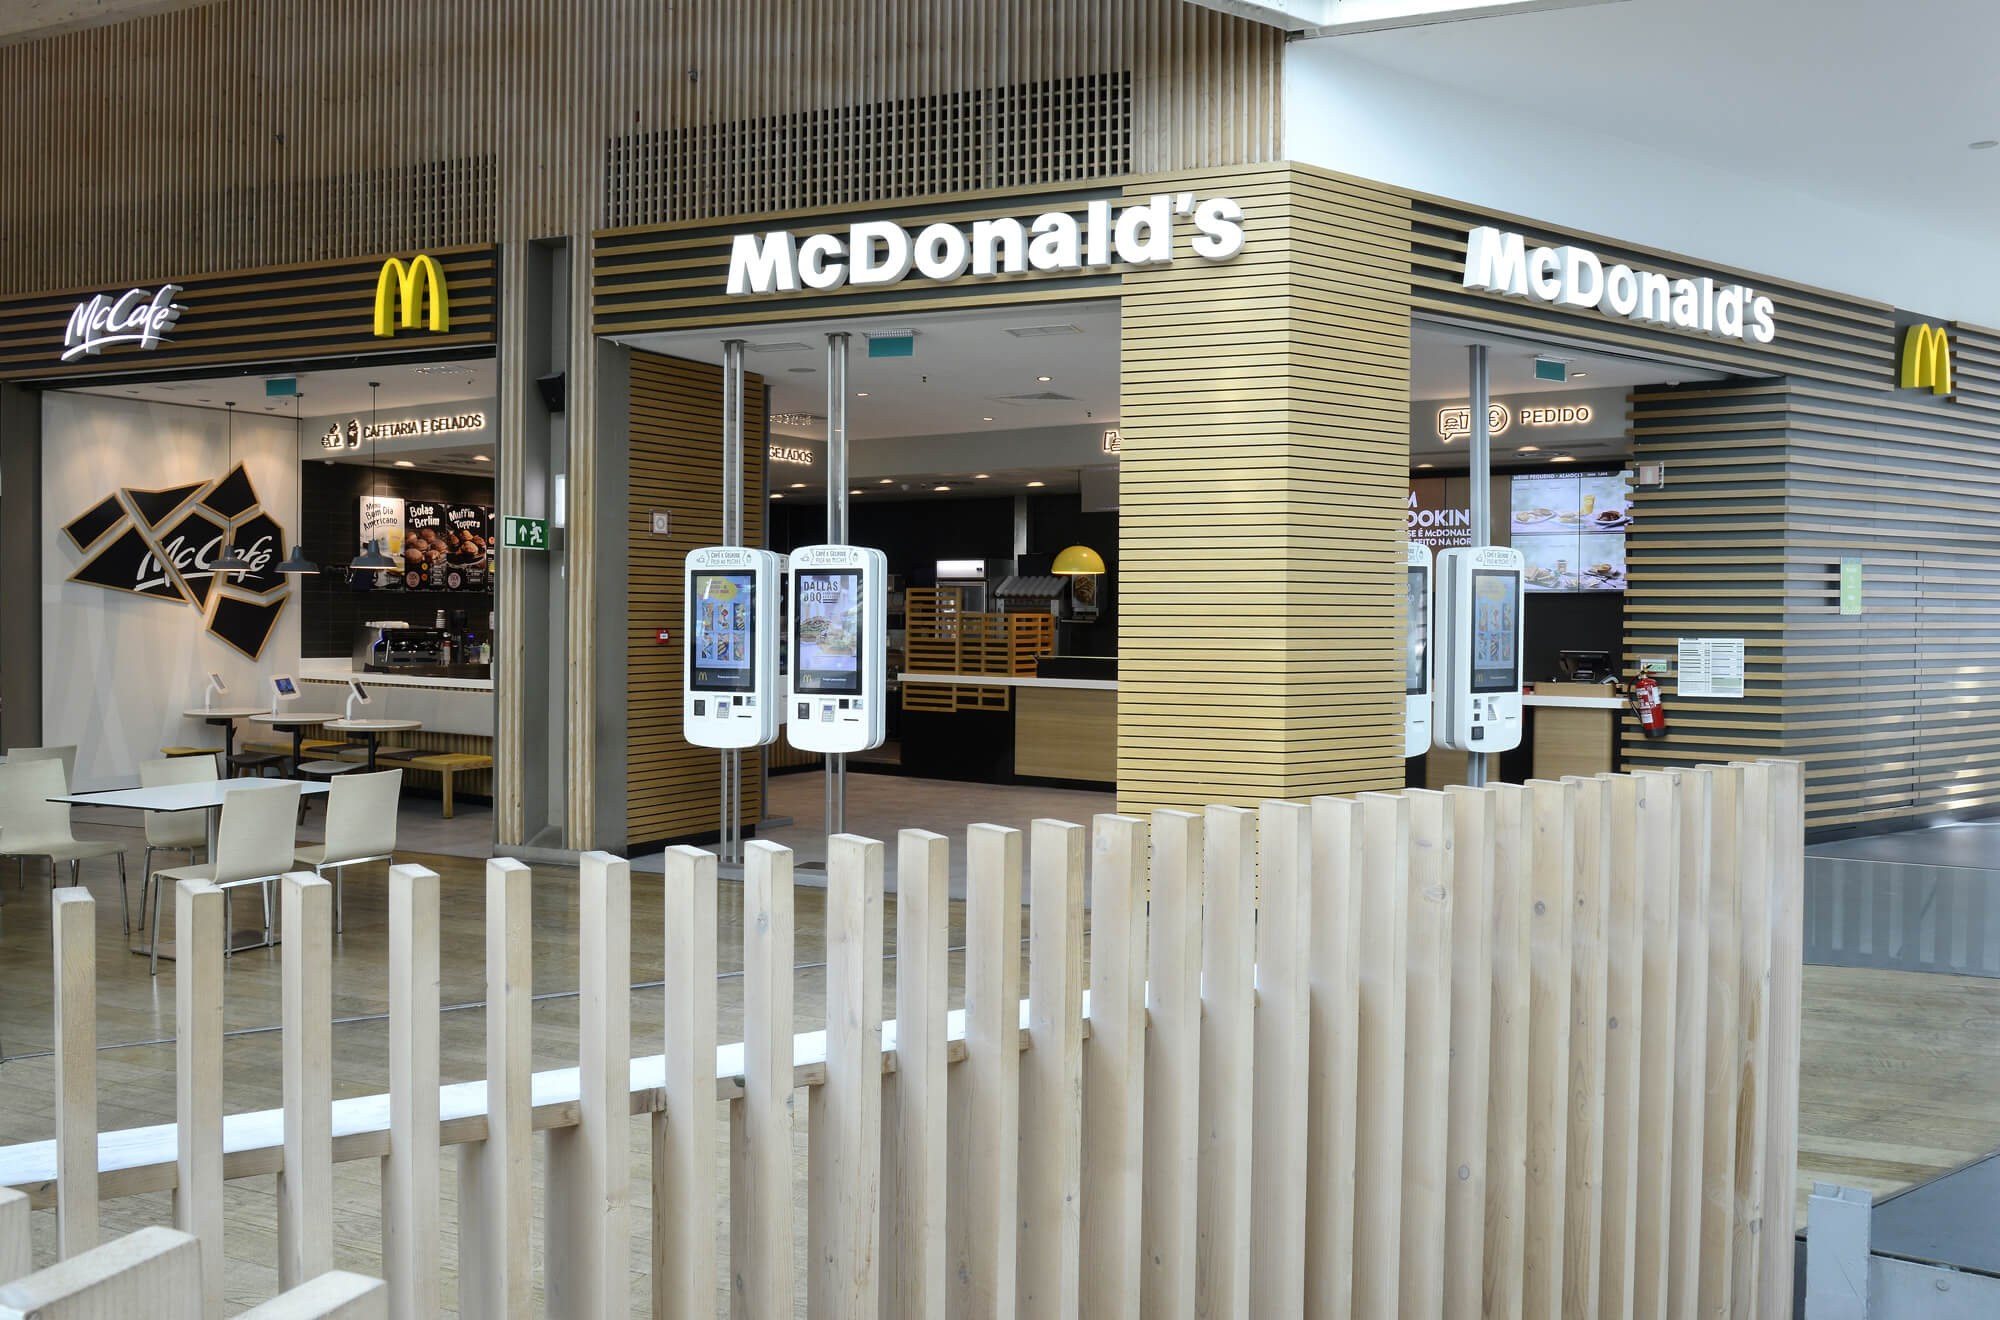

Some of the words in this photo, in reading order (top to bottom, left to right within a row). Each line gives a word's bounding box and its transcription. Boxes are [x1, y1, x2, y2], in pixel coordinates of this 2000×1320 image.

[726, 193, 1244, 296] McDonald's
[1462, 226, 1775, 345] McDonald's
[62, 284, 188, 358] McCafé
[1520, 407, 1589, 424] PEDIDO
[363, 422, 419, 439] CAFETARIA
[421, 420, 431, 433] E
[431, 414, 483, 432] GELADOS
[769, 446, 813, 463] GELADOS
[365, 510, 381, 520] Bom
[383, 506, 393, 515] Dia
[409, 503, 434, 518] Bolas
[448, 508, 475, 521] Muffin
[363, 517, 398, 531] Americano
[414, 515, 440, 528] Berlim
[454, 519, 481, 530] Toppers
[1408, 509, 1470, 528] OOKIN
[1425, 528, 1472, 538] McDONALD
[1439, 537, 1452, 546] NA
[1453, 537, 1472, 546] HOR
[134, 536, 273, 590] McCfé
[803, 581, 838, 591] DALLAS
